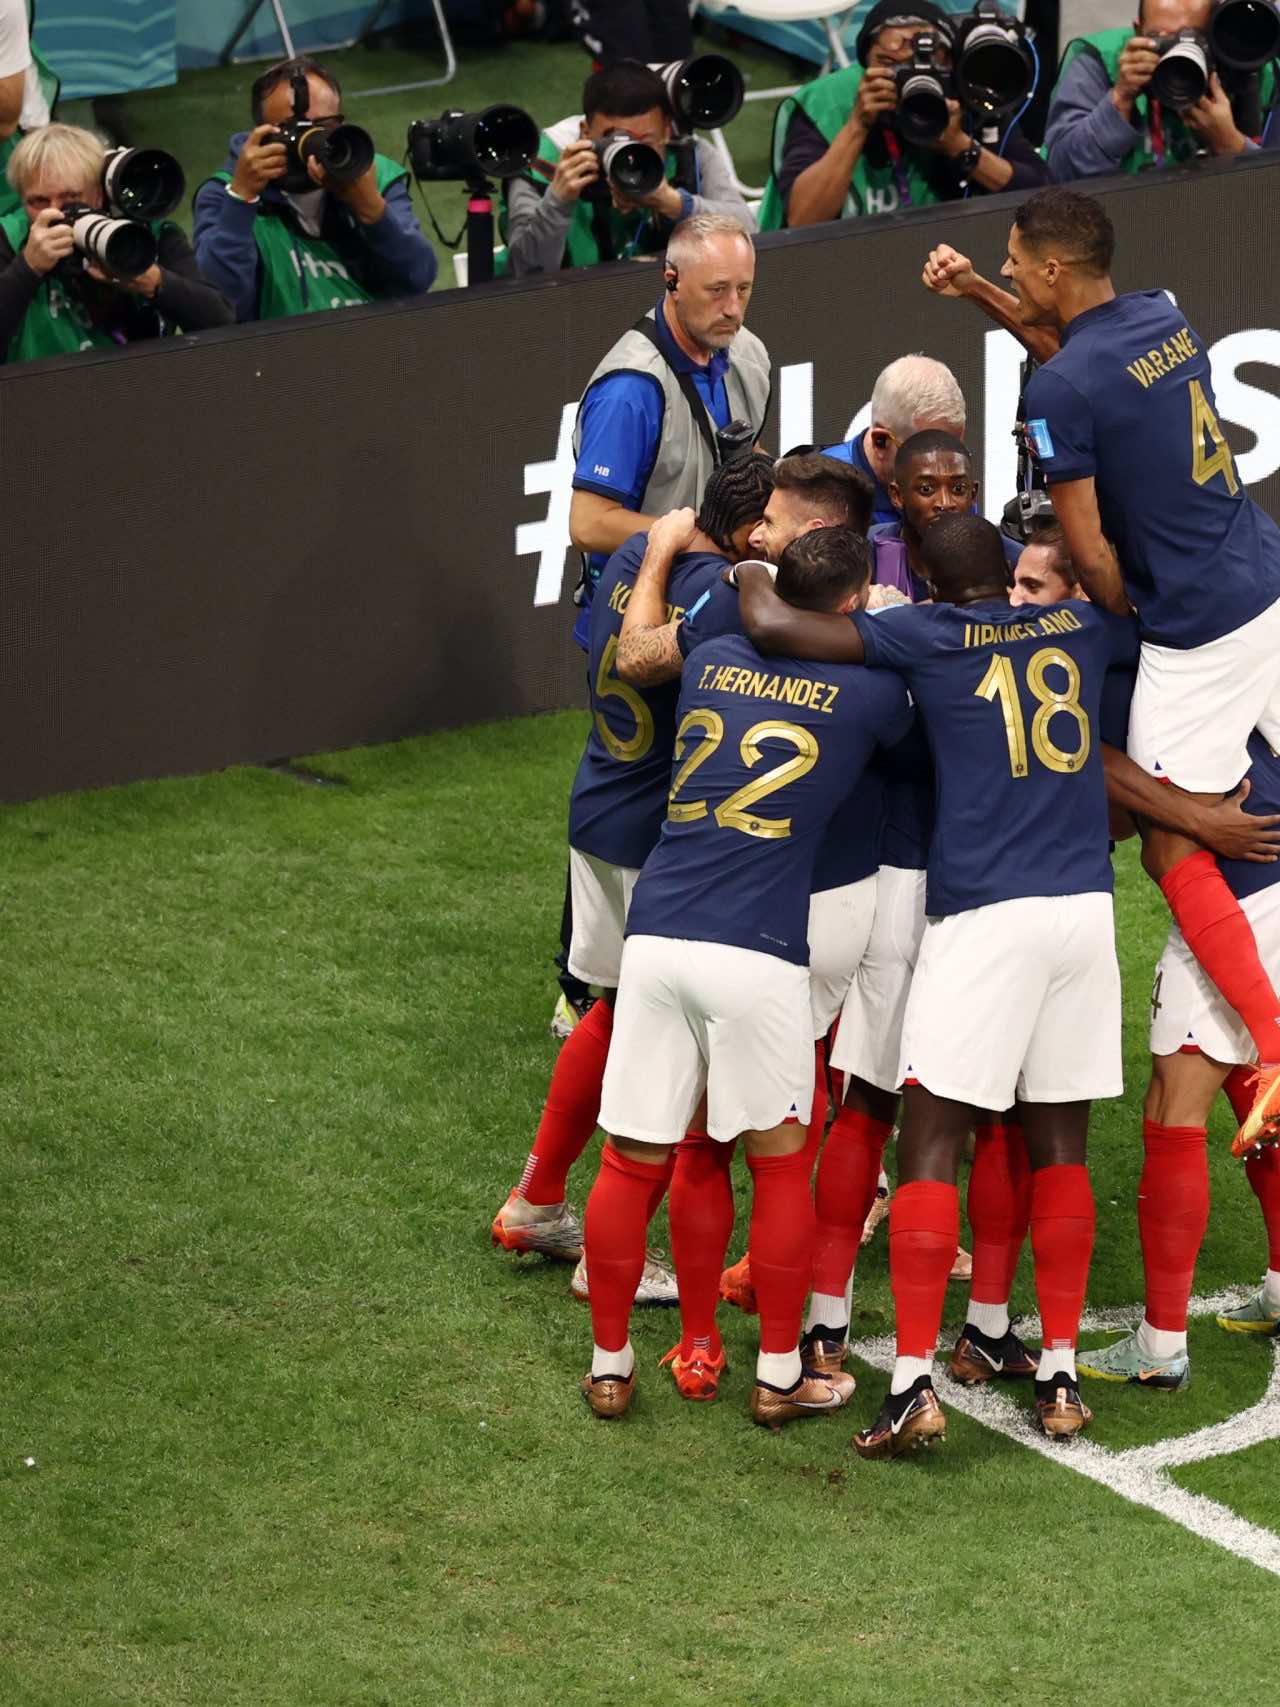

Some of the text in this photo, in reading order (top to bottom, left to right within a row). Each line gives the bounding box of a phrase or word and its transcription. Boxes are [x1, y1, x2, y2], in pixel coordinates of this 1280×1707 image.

[1126, 327, 1198, 388] VARANE
[593, 464, 610, 477] HB
[1189, 379, 1240, 496] 4
[596, 633, 655, 762] 5
[698, 664, 840, 714] T.HERNANDEZ
[974, 647, 1091, 778] 18
[667, 708, 820, 839] 22
